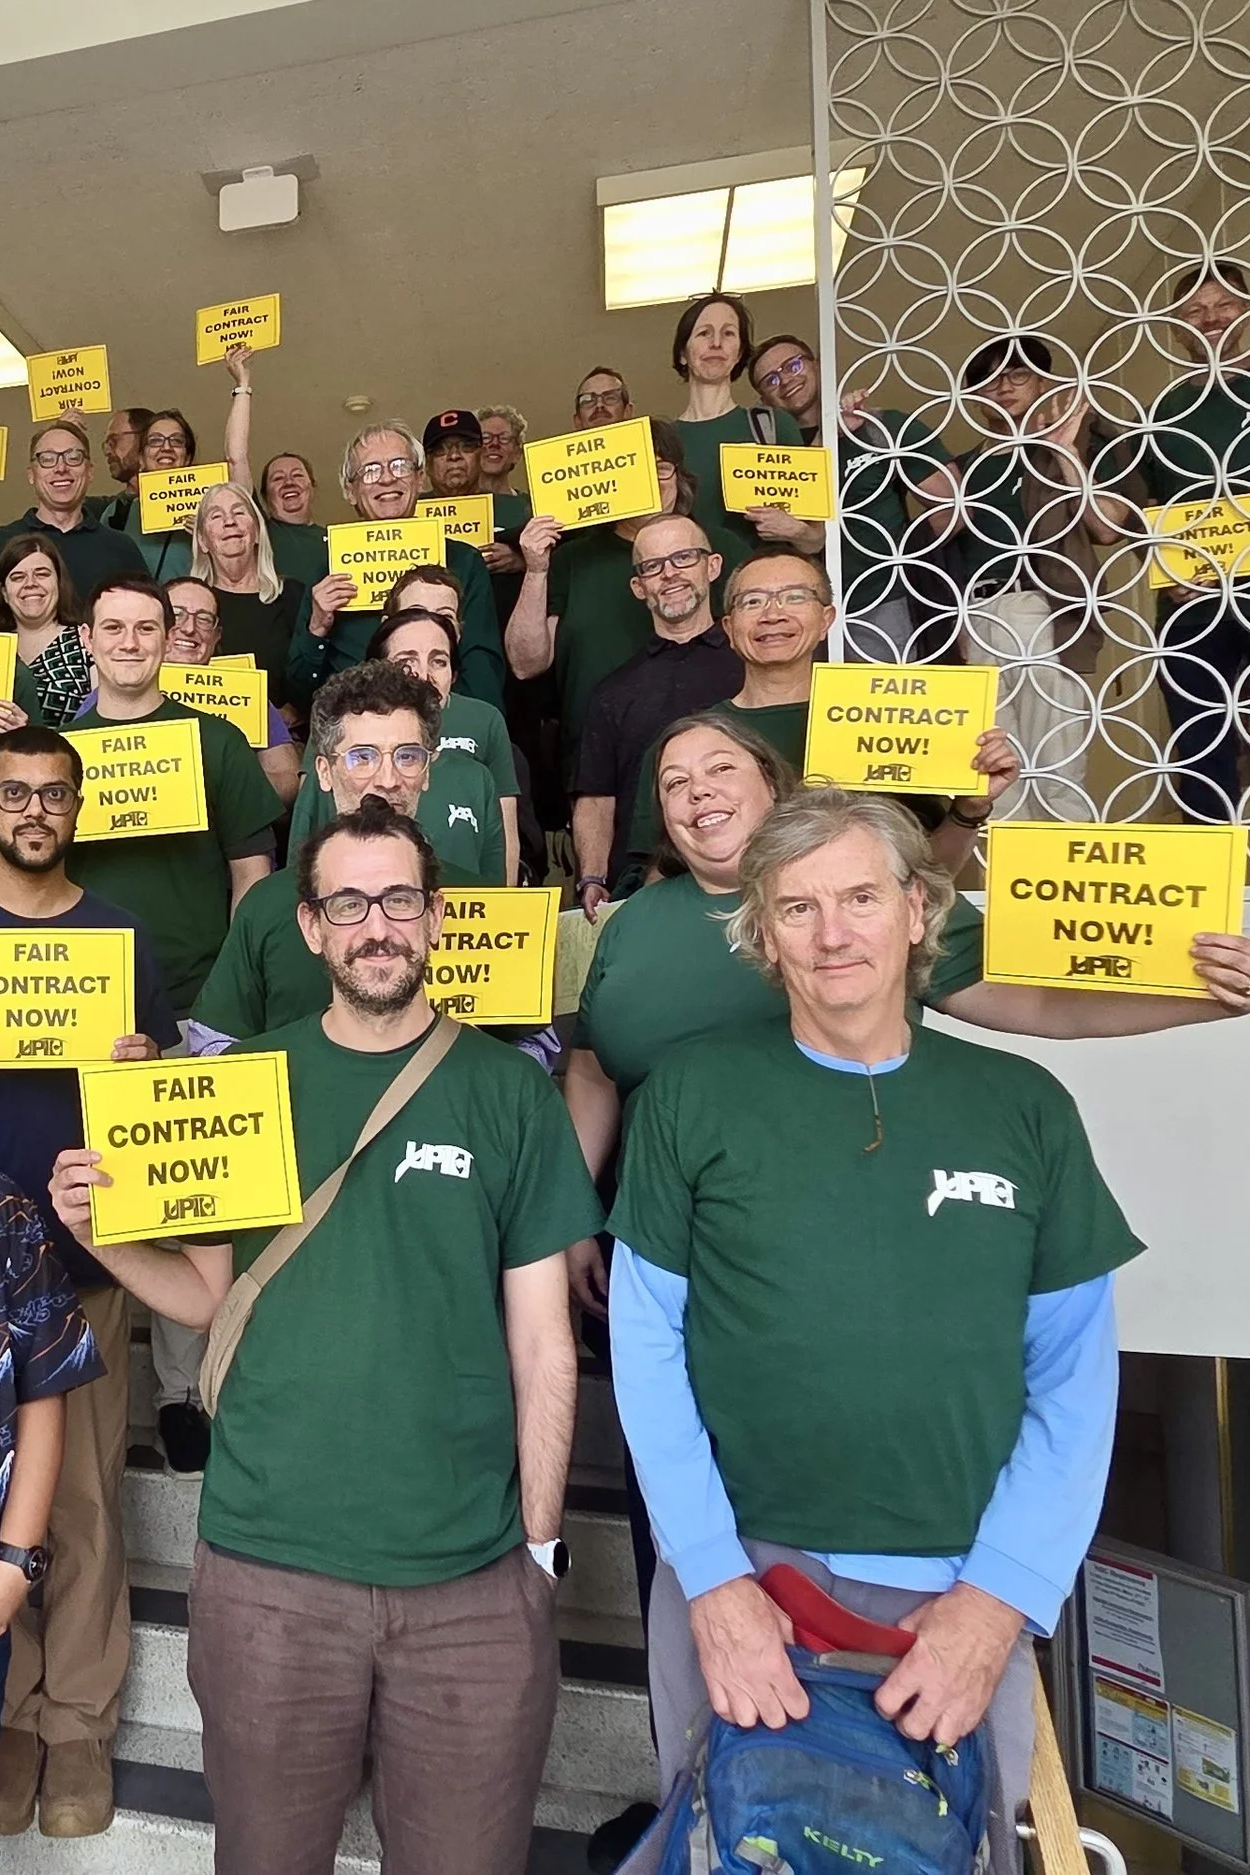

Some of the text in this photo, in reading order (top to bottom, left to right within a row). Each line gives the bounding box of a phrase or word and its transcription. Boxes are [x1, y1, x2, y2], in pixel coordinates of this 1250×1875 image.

[223, 305, 250, 317] FAIR
[205, 314, 269, 334] CONTRACT
[219, 329, 253, 342] NOW!
[52, 367, 84, 380] NOW!
[40, 380, 101, 398] CONTRACT
[58, 398, 83, 410] FAIR
[440, 412, 458, 427] C
[566, 437, 606, 457] FAIR
[757, 453, 792, 464] FAIR
[541, 453, 637, 485] CONTRACT
[732, 469, 818, 482] CONTRACT
[168, 473, 196, 484] FAIR
[567, 483, 617, 501] NOW!
[754, 486, 799, 498] NOW!
[166, 501, 200, 512] NOW
[426, 505, 457, 518] FAIR
[366, 529, 402, 542] FAIR
[444, 522, 481, 535] RACT
[341, 547, 430, 564] CONTRACT
[185, 673, 223, 687] FAIR
[870, 678, 927, 695] FAIR
[827, 705, 969, 726] CONTRACT
[102, 735, 146, 753] FAIR
[857, 736, 929, 755] NOW!
[85, 758, 182, 780] ONTRACT
[99, 786, 157, 806] NOW!
[1068, 841, 1146, 865] FAIR
[1010, 878, 1207, 908] CONTRACT
[443, 902, 486, 919] AIR
[1054, 919, 1153, 946] NOW!
[14, 943, 69, 961] FAIR
[5, 1009, 77, 1027] NOW!
[153, 1076, 215, 1102] FAIR
[108, 1112, 264, 1148] CONTRACT
[148, 1156, 229, 1186] NOW!
[803, 1826, 884, 1868] KELTY
